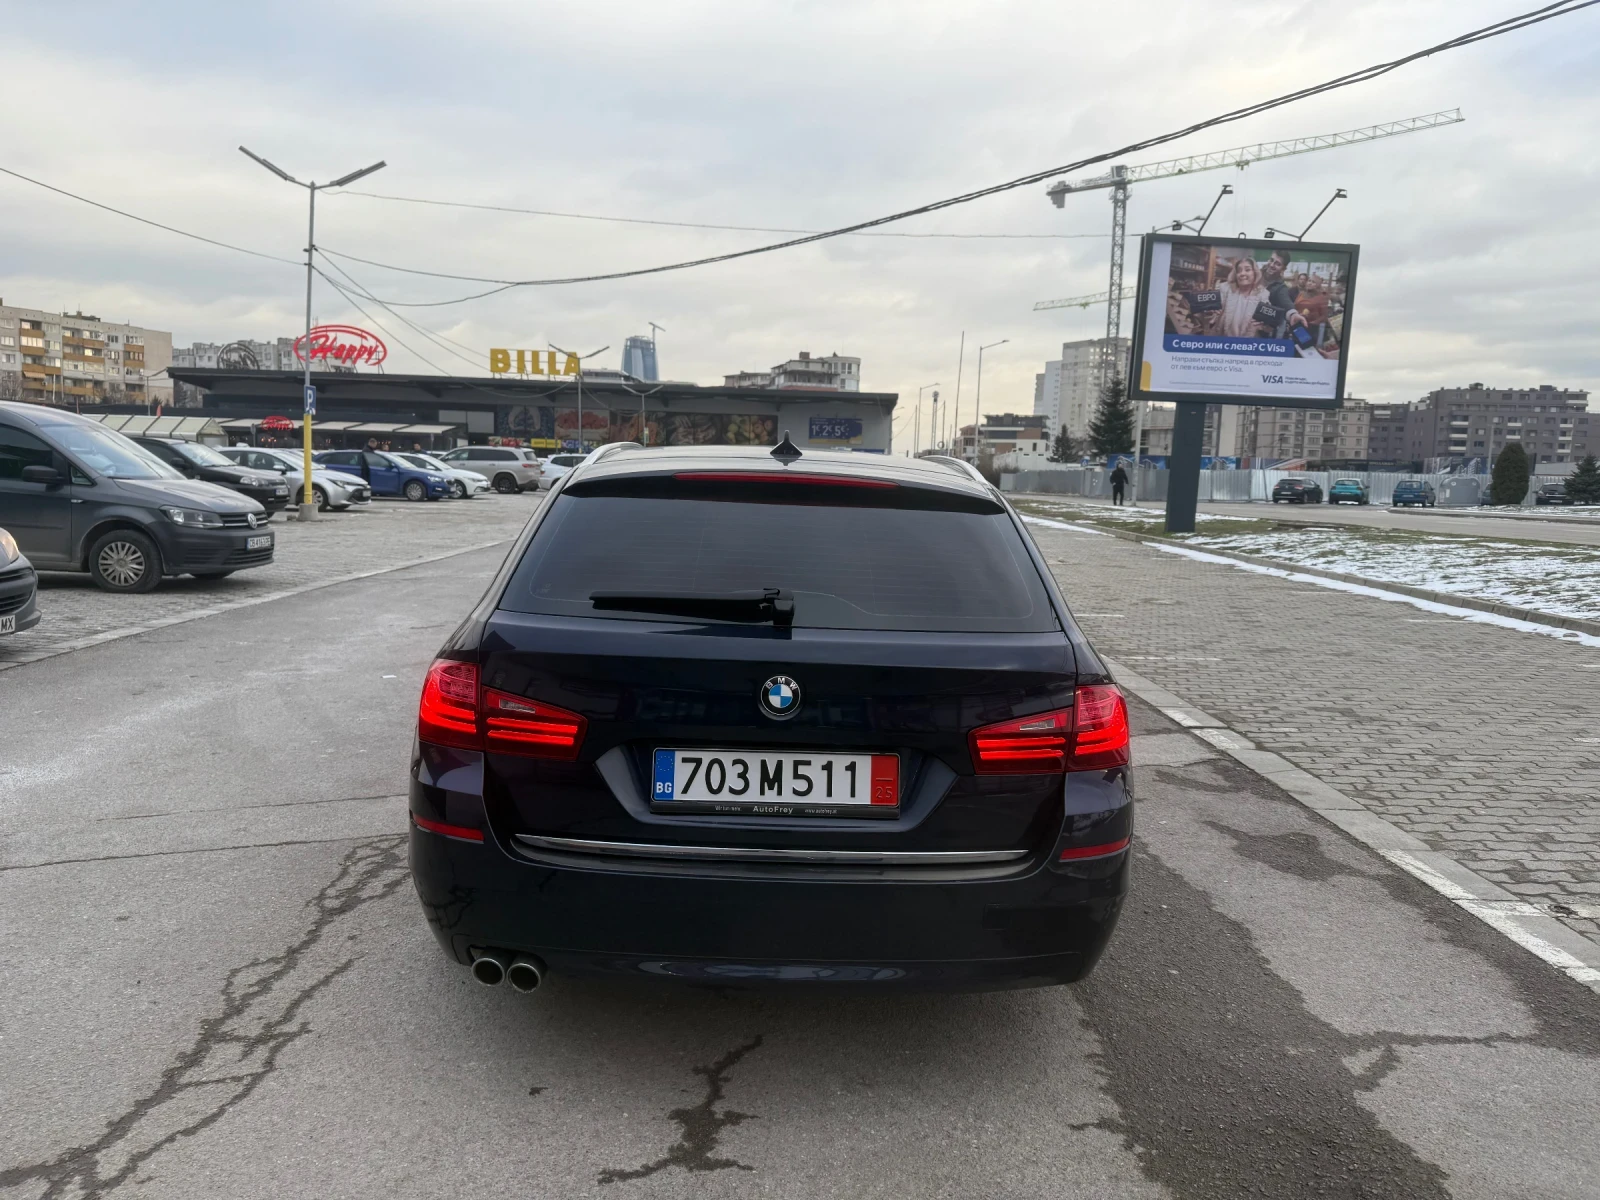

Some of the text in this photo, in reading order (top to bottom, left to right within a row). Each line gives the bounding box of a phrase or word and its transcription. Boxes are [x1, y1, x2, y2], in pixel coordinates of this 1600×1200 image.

[1197, 293, 1216, 302] ЕВРО
[1259, 306, 1276, 318] ЛЕВА
[308, 334, 379, 365] Happy
[1172, 339, 1179, 348] С
[1180, 341, 1204, 350] евро
[1205, 342, 1223, 350] или
[1230, 343, 1258, 351] лева?
[1266, 343, 1286, 353] Visa
[490, 348, 578, 376] BILLA
[1171, 355, 1201, 363] Направи
[1224, 358, 1249, 366] напред
[1261, 374, 1284, 384] VISA
[307, 389, 314, 411] P
[765, 677, 798, 690] BMW
[656, 782, 672, 794] BG
[876, 786, 893, 799] 25
[752, 805, 794, 815] AutoFrey
